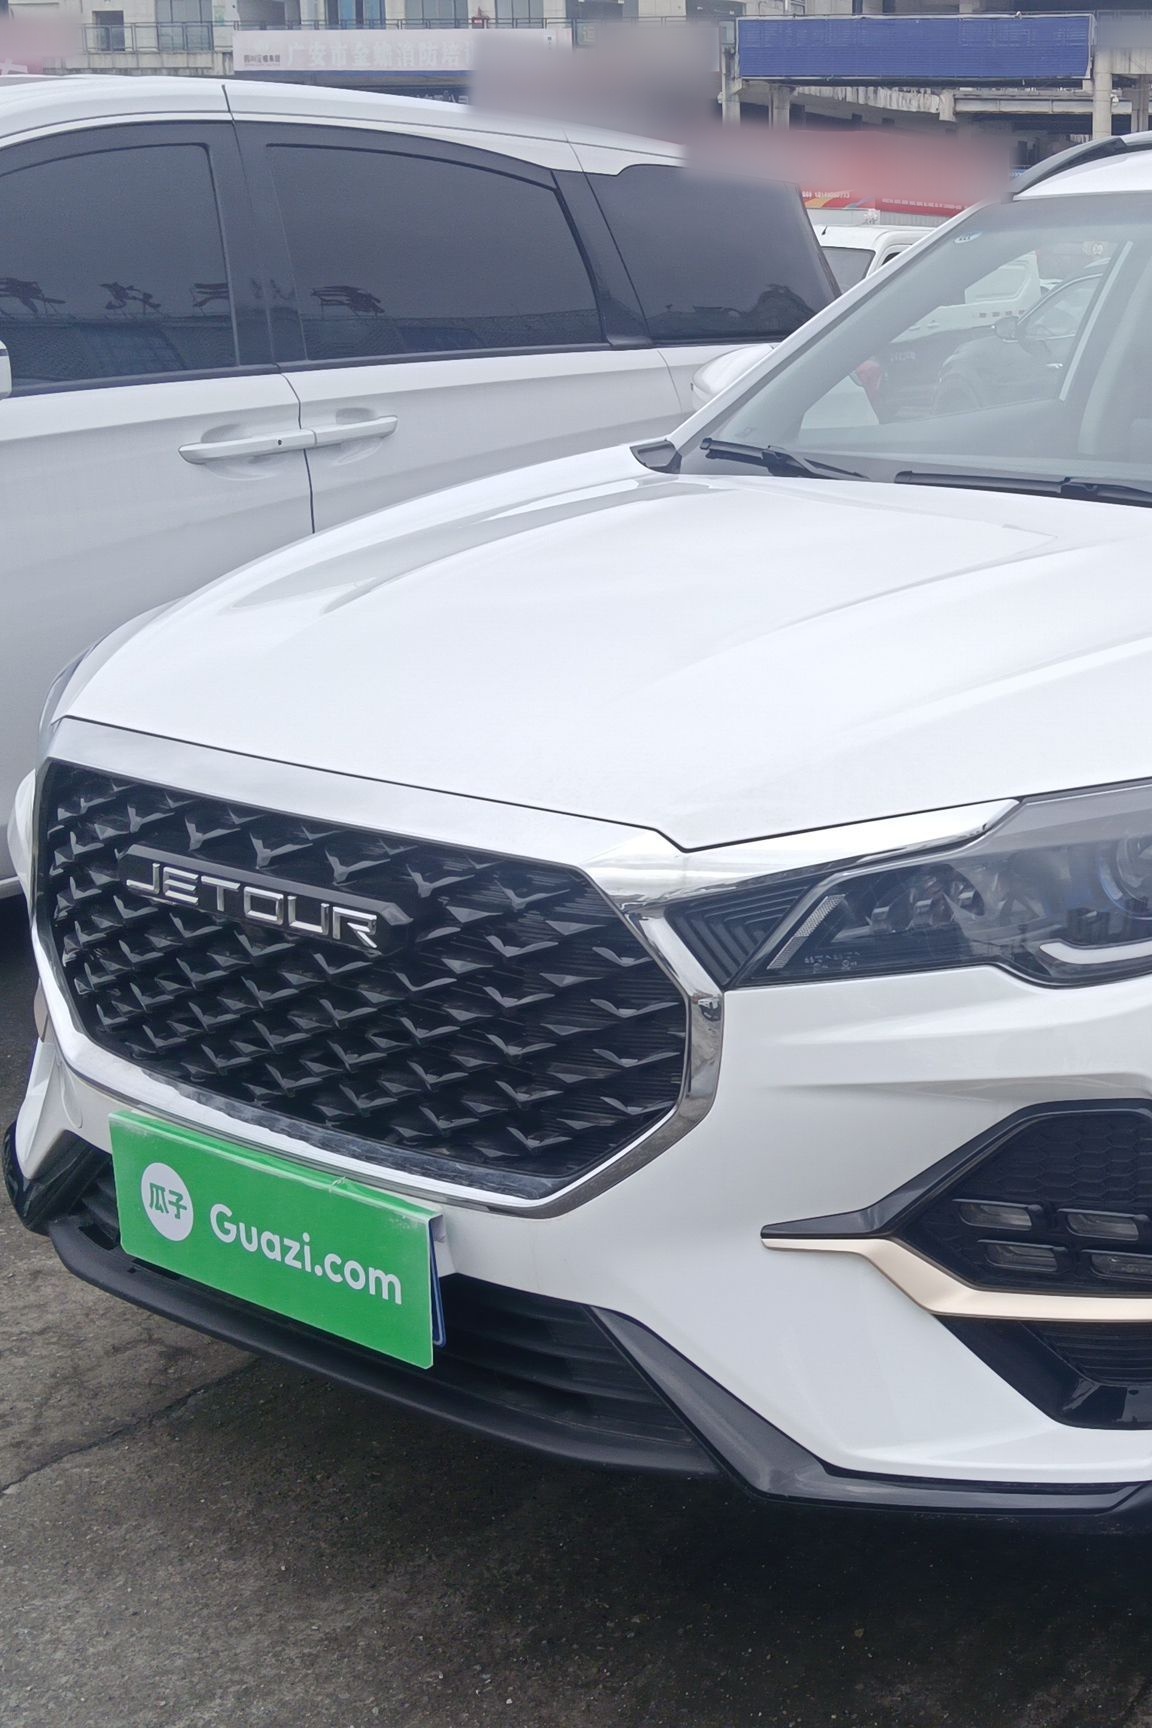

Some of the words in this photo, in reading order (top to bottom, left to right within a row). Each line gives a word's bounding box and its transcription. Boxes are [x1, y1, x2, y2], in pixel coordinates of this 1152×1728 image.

[126, 862, 378, 949] JETOUR
[149, 1182, 188, 1220] 瓜子
[209, 1203, 402, 1305] Guazi.com
